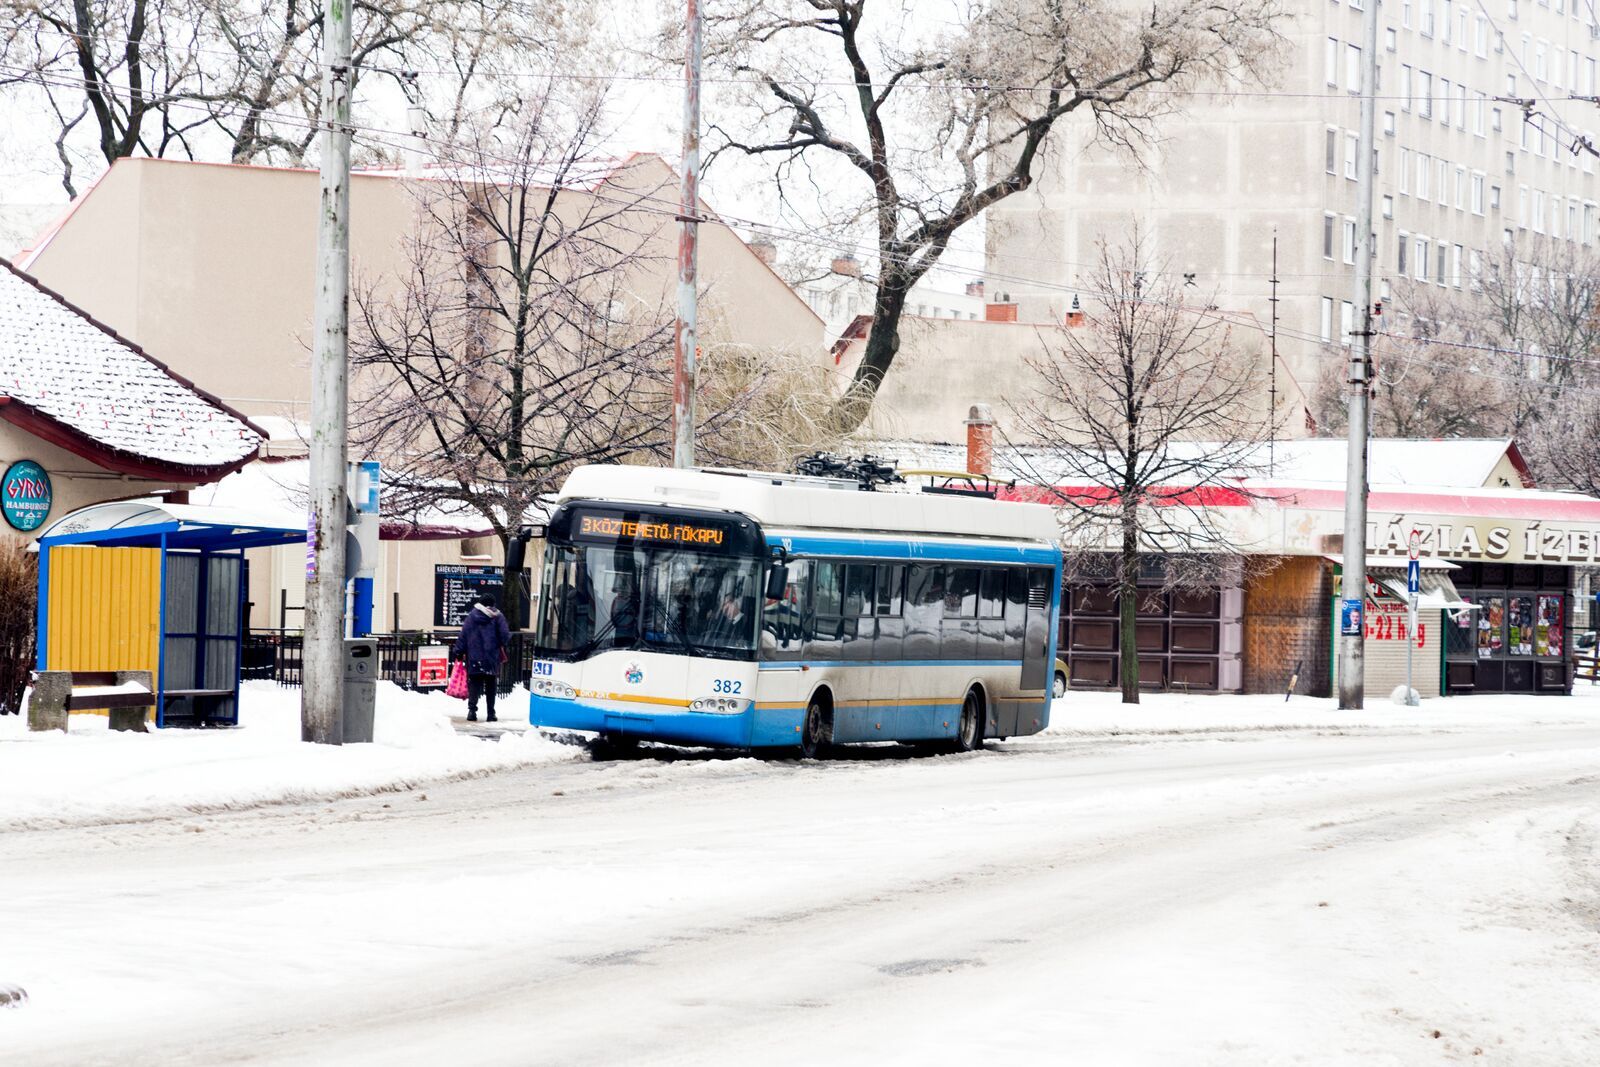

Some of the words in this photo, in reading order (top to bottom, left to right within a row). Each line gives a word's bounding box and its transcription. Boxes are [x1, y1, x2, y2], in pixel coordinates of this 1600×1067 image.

[6, 477, 49, 499] GYROS
[582, 516, 592, 533] 3
[673, 524, 724, 545] FŐKAPU
[1523, 519, 1600, 562] ÍZE
[712, 678, 743, 695] 382
